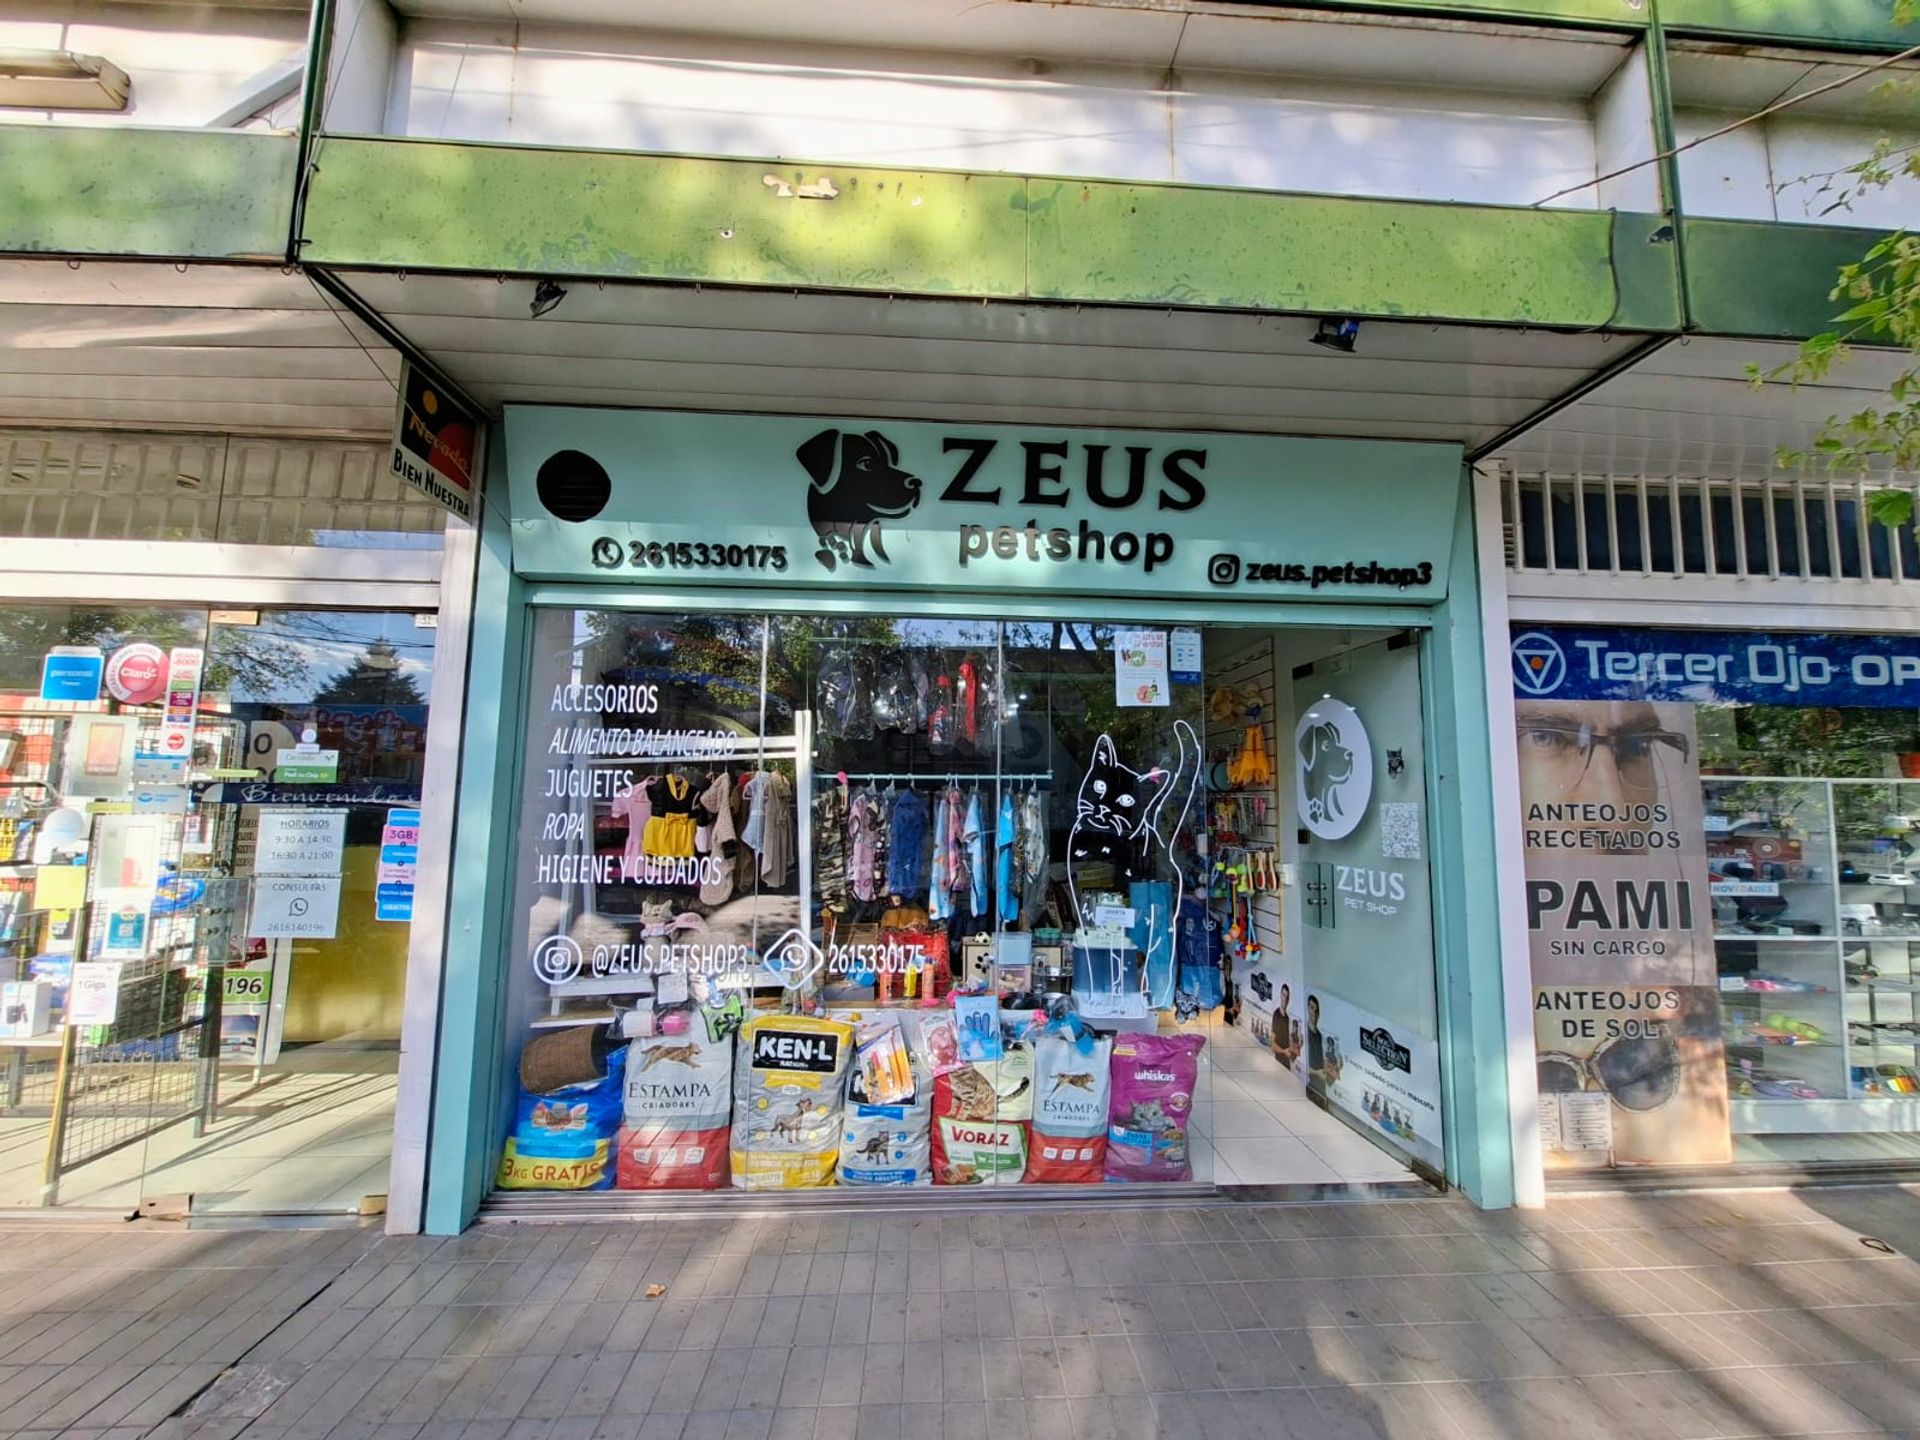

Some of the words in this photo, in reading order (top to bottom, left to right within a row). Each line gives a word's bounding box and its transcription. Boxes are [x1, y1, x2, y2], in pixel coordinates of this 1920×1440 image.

[409, 415, 469, 471] Nevada
[939, 437, 1208, 512] ZEUS
[627, 539, 788, 570] 2615330175
[959, 519, 1174, 572] petshop
[1245, 560, 1433, 589] zeus.petshop3
[120, 666, 151, 680] Claro
[1575, 640, 1734, 684] Tercer
[1747, 644, 1831, 692] Ojo
[551, 684, 659, 714] ACCESORIOS
[548, 727, 631, 756] ALIMENTO
[633, 729, 738, 757] BALANCEADO
[241, 783, 420, 803] Bienvenidos
[546, 769, 633, 799] JUGUETES
[1528, 804, 1668, 822] ANTEOJOS
[280, 820, 330, 830] HORARIOS
[543, 813, 585, 841] ROPA
[1526, 830, 1681, 849] RECETADOS
[538, 855, 614, 885] HIGIENE
[617, 857, 631, 885] Y
[633, 857, 722, 886] CUIDADOS
[272, 883, 327, 892] CONSULTAS
[1336, 865, 1406, 901] ZEUS
[1712, 884, 1773, 893] NOVEDADES
[1344, 897, 1364, 909] PET
[1366, 902, 1397, 915] SHOP
[1526, 880, 1694, 931] PAMI
[1550, 940, 1585, 955] SIN
[1593, 940, 1666, 956] CARGO
[592, 943, 748, 975] @ZEUS.PETSHOP3
[829, 944, 924, 974] 2615330175
[224, 977, 263, 994] 196
[1536, 991, 1680, 1010] ANTEOJOS
[1562, 1019, 1595, 1038] DE
[1606, 1019, 1659, 1038] SOL
[759, 1036, 833, 1061] KEN-L
[1134, 1070, 1176, 1082] whiskas
[628, 1081, 711, 1099] ESTAMPA
[642, 1101, 696, 1110] CRIADORES
[1043, 1099, 1100, 1114] ESTAMPA
[952, 1126, 1009, 1147] VORAZ
[532, 1160, 601, 1182] GRATIS
